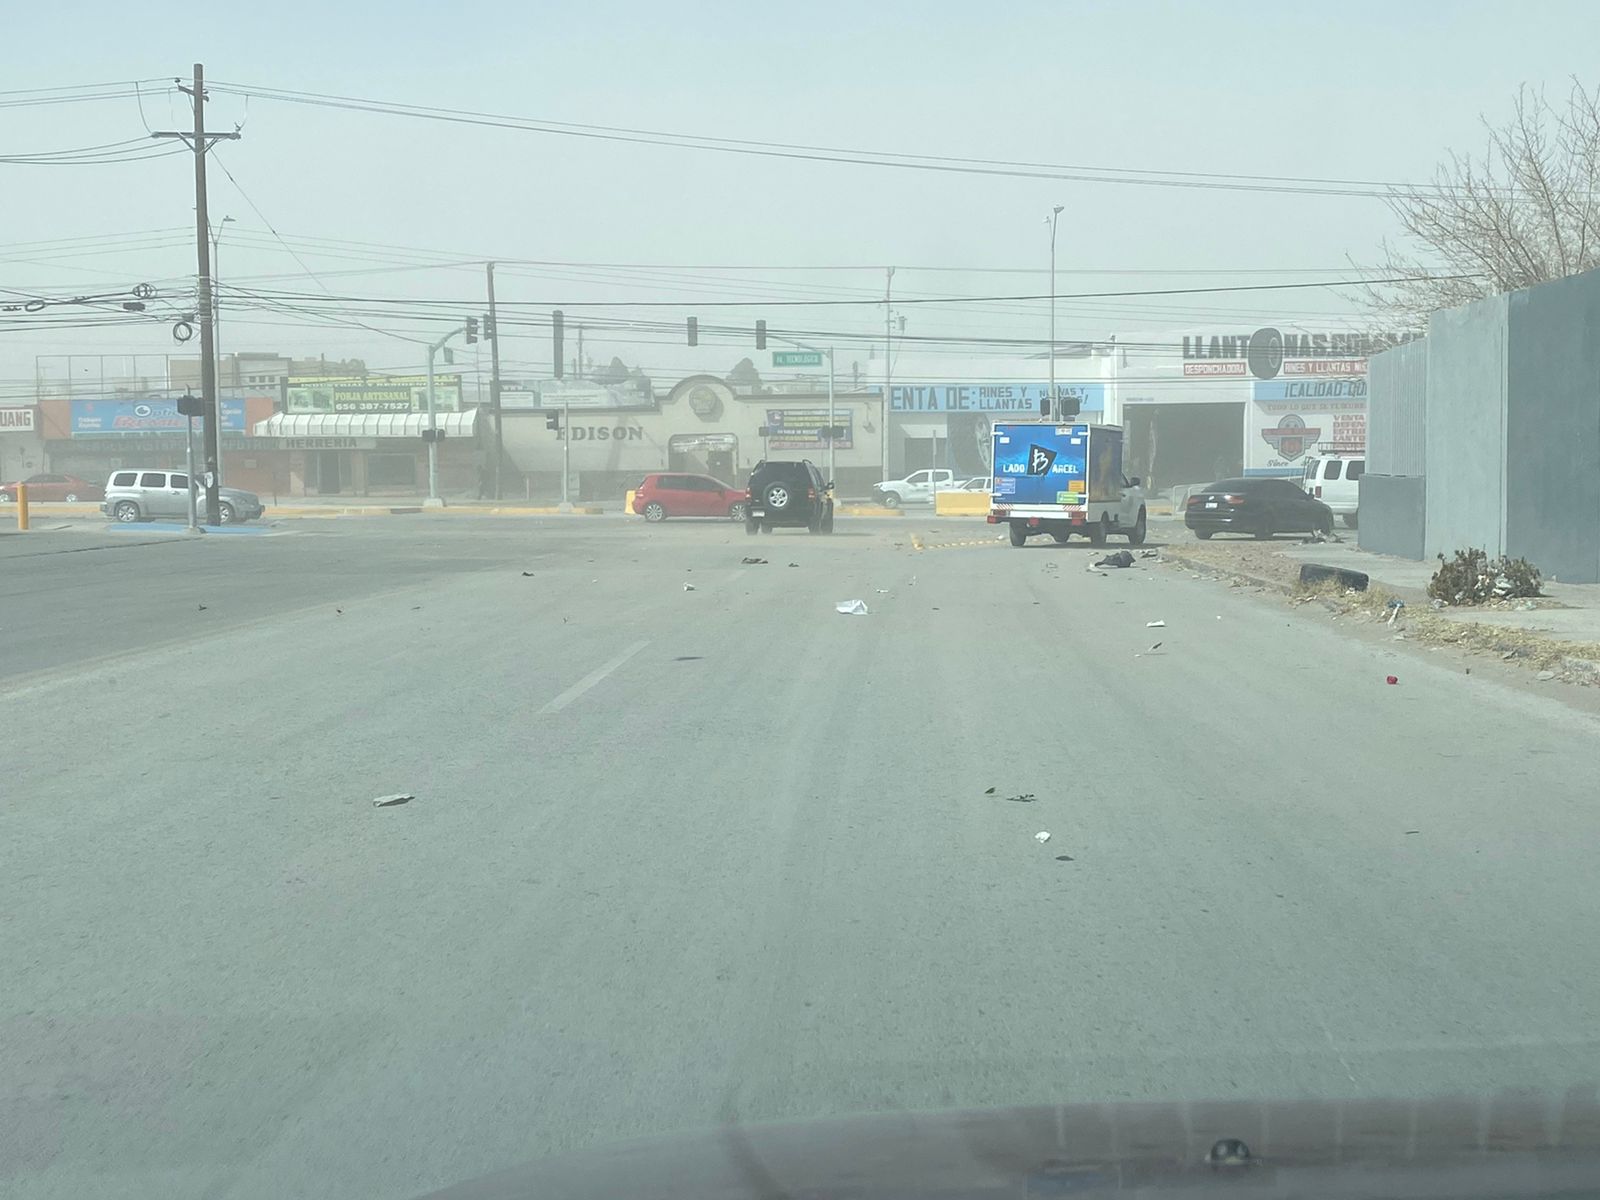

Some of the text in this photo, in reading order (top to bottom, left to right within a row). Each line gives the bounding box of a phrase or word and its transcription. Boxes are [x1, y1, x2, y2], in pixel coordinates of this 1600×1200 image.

[979, 386, 1028, 397] RINES Y
[979, 399, 1032, 409] LLANTAS
[286, 438, 357, 448] HERRERIA
[1003, 464, 1025, 473] LADO
